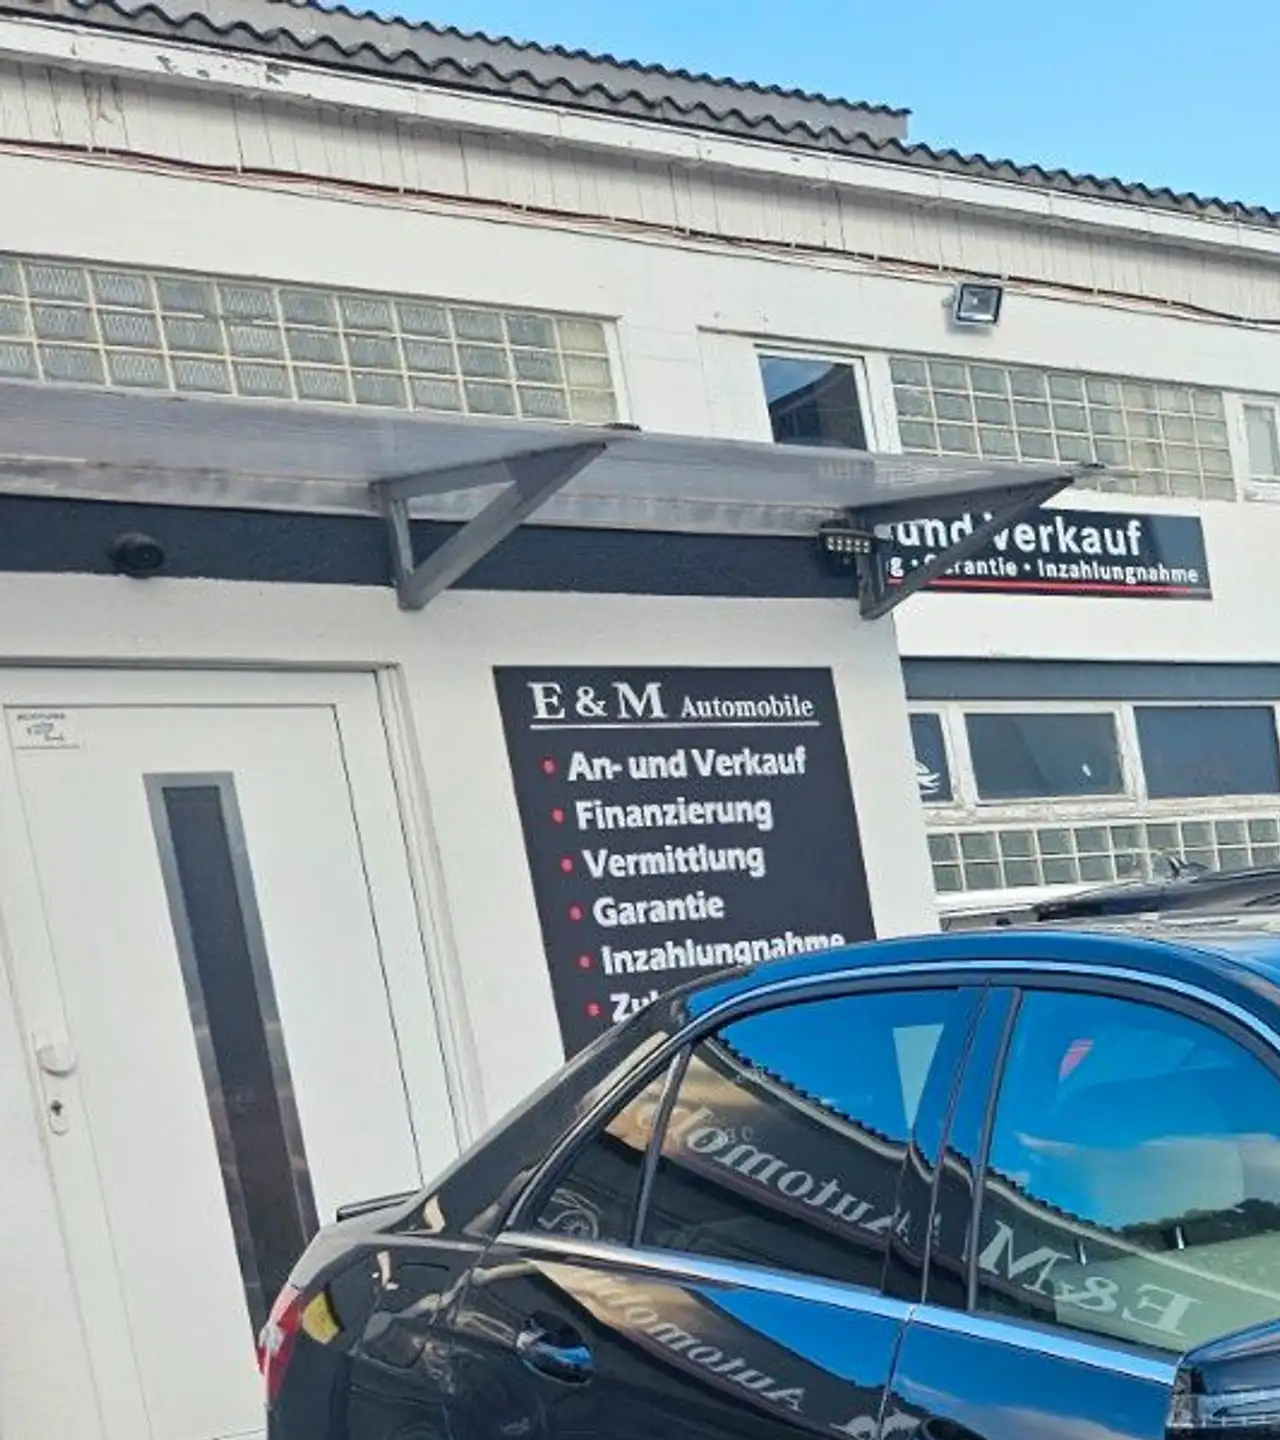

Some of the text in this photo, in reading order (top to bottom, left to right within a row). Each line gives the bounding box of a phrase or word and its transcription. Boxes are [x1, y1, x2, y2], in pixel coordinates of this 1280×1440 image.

[1037, 558, 1199, 585] Inzahlungnahme
[681, 694, 815, 718] Automobile
[568, 745, 806, 781] An- und Verkauf
[575, 797, 774, 831] Finanzierung
[581, 843, 767, 878] Vermittlung
[592, 890, 725, 928] Garantie
